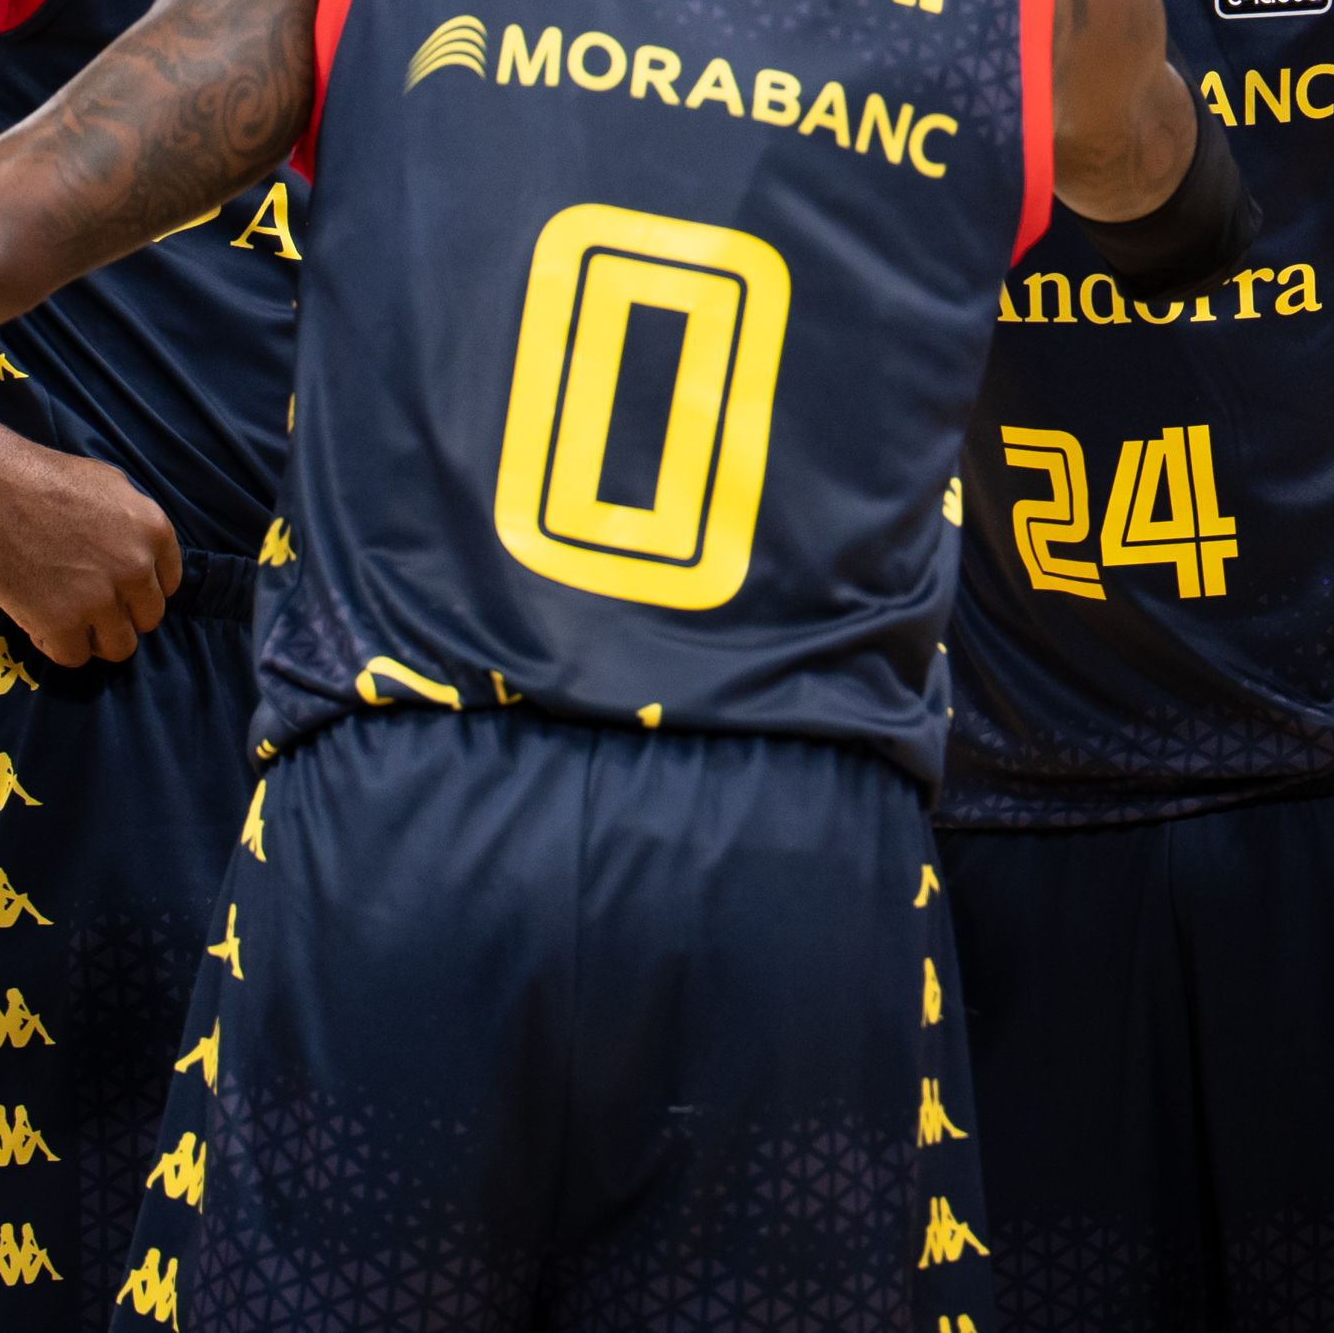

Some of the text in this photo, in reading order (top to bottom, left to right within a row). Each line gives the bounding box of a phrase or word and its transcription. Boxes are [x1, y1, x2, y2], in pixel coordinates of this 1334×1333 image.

[496, 23, 958, 178] MORABANC
[494, 203, 791, 611] 0
[1000, 424, 1238, 600] 24
